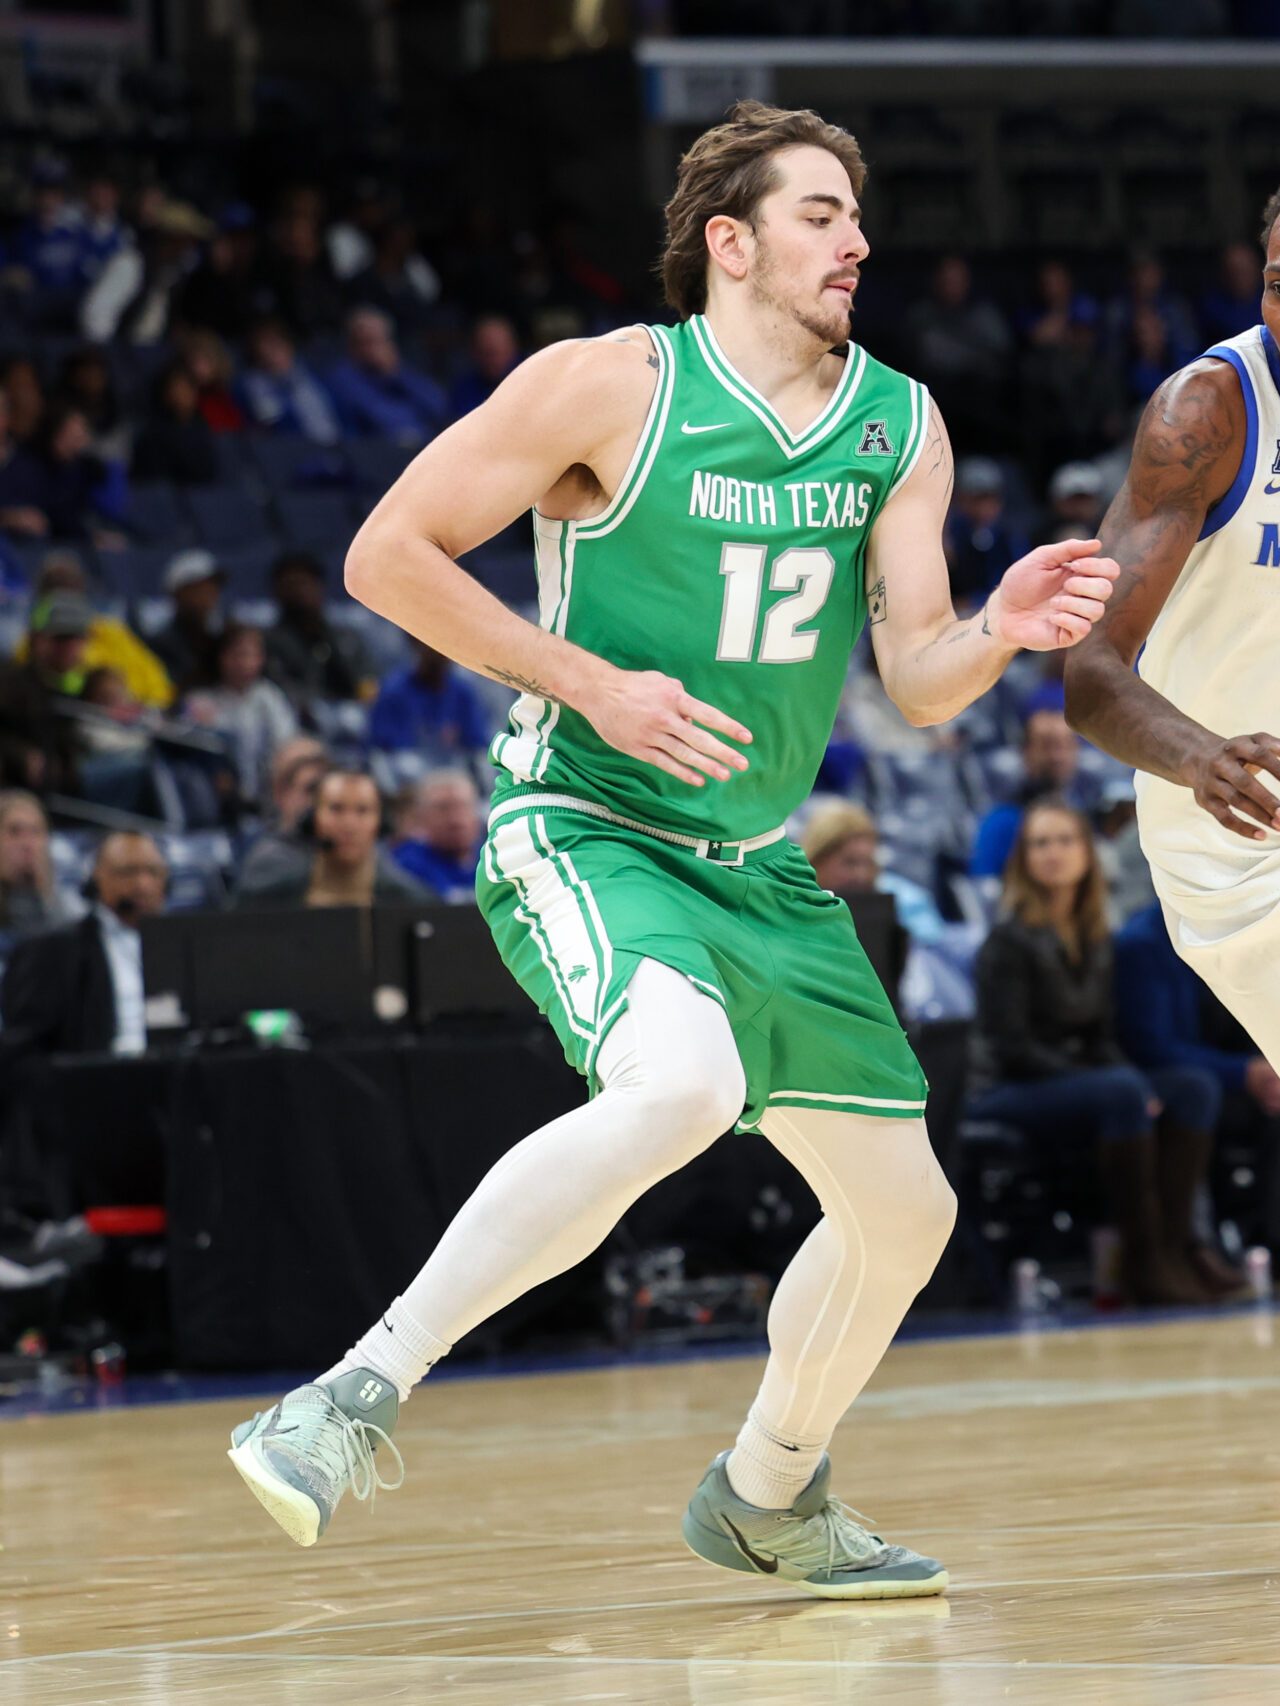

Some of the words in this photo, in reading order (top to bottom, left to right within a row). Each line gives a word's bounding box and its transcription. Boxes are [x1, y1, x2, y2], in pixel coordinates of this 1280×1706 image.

[858, 421, 893, 454] A
[688, 470, 777, 526] NORTH
[784, 482, 873, 528] TEXAS
[715, 541, 836, 664] 12
